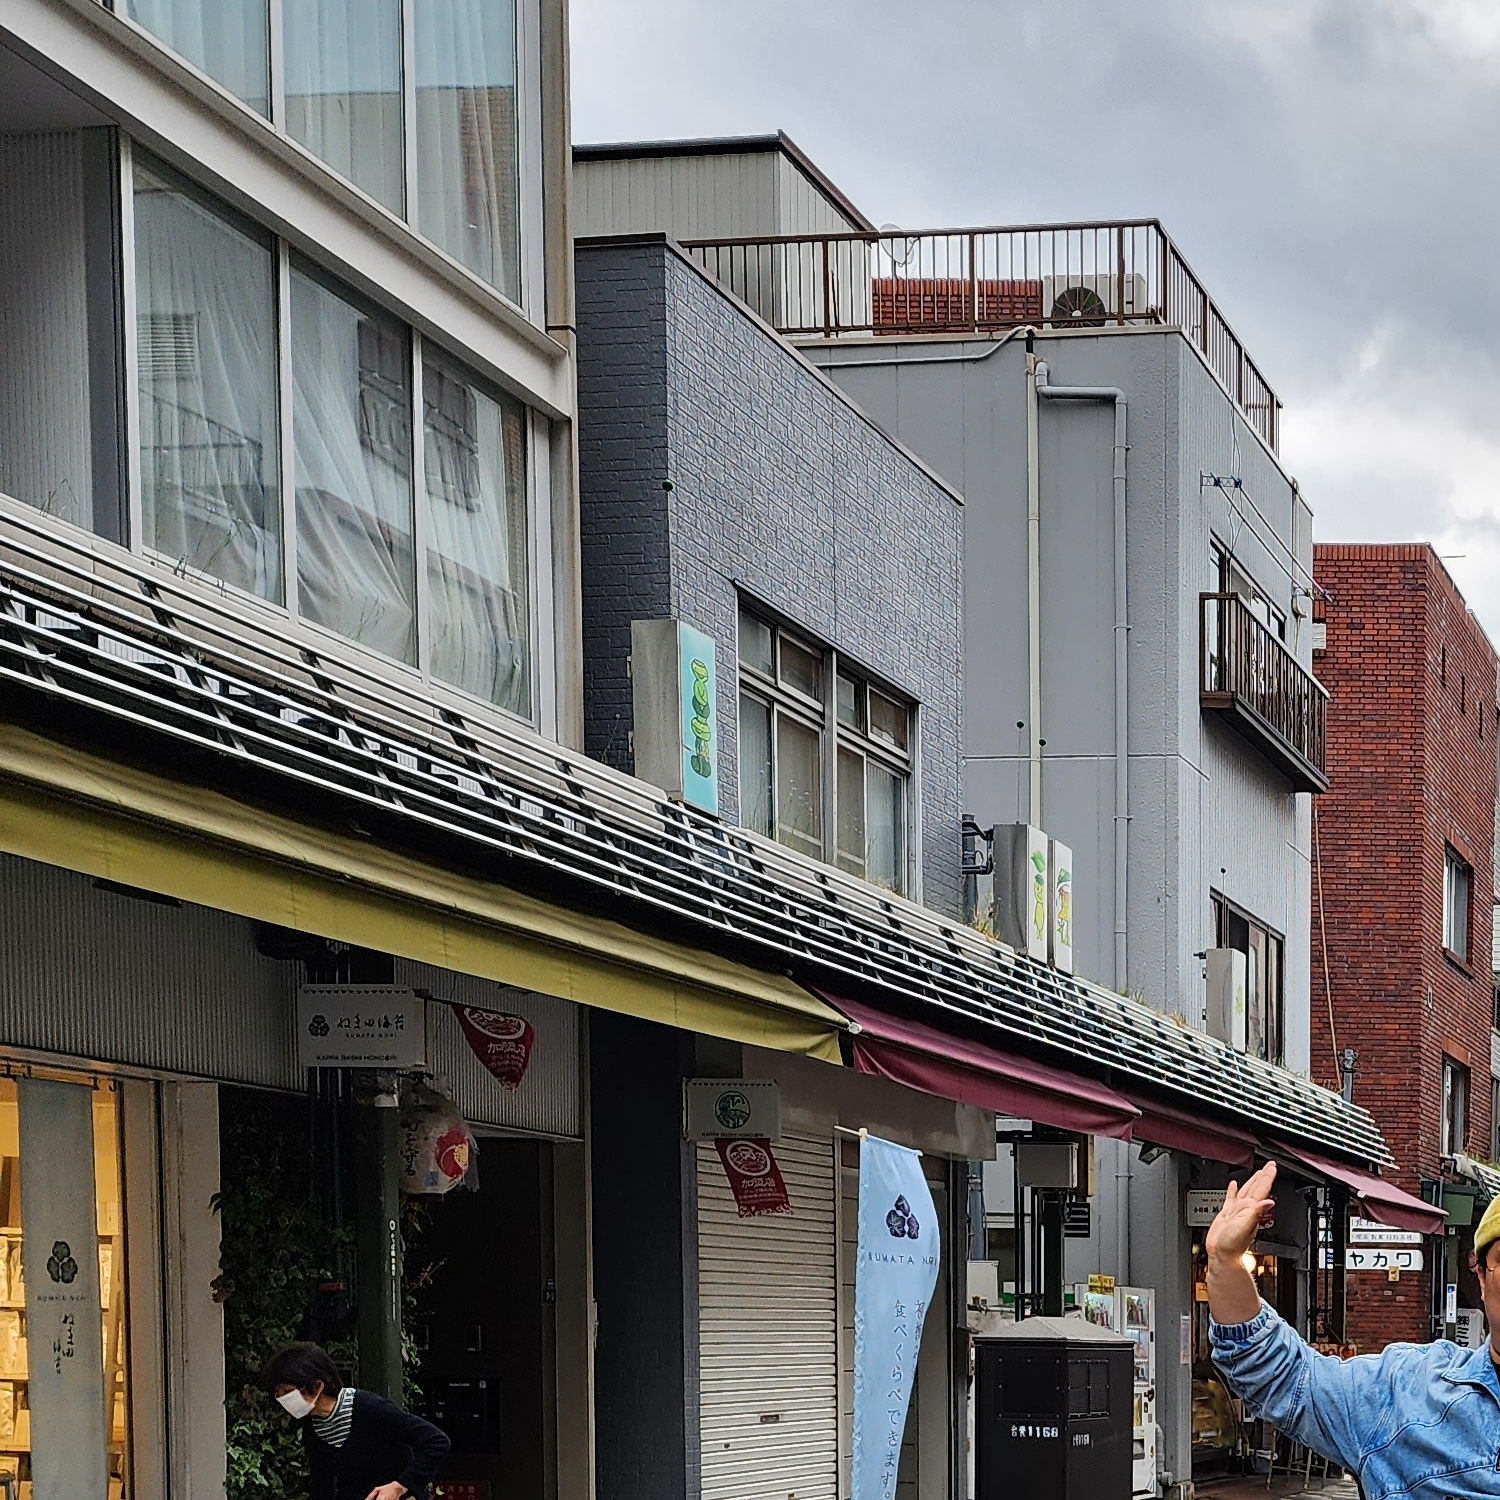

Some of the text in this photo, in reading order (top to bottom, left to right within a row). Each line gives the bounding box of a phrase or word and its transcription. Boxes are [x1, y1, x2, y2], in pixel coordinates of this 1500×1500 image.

[881, 1299, 908, 1499] 食べくらべできます。
